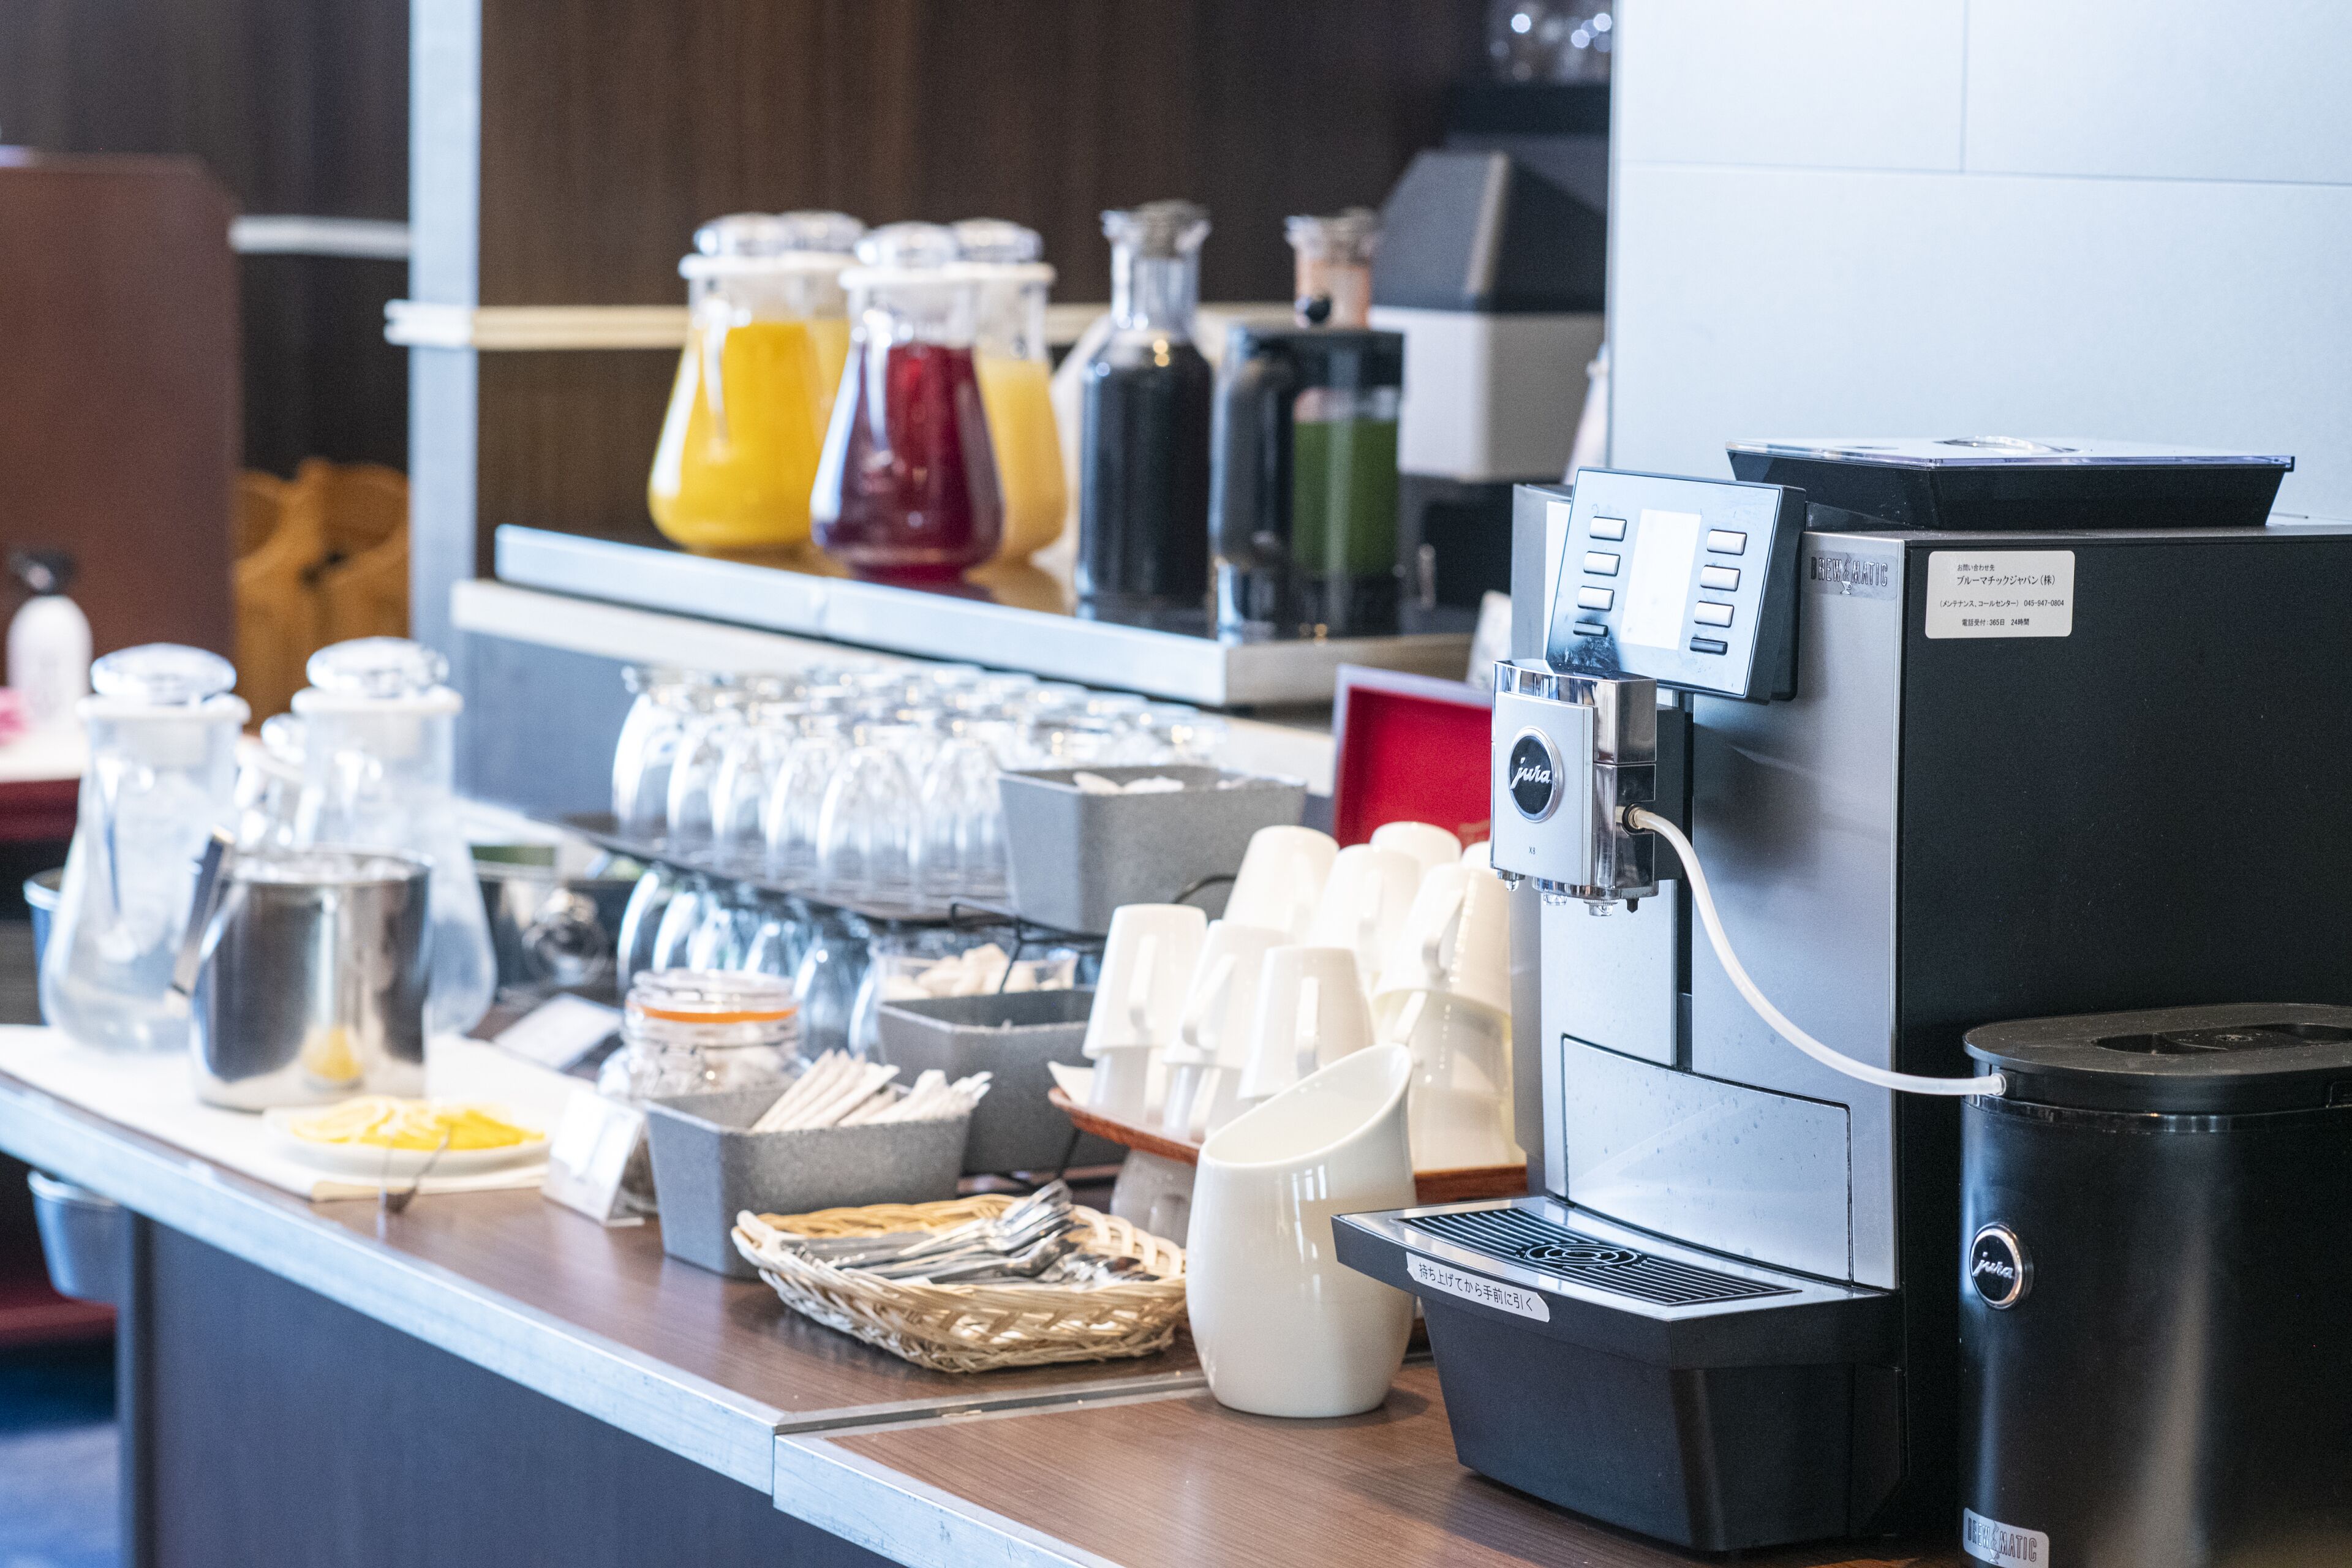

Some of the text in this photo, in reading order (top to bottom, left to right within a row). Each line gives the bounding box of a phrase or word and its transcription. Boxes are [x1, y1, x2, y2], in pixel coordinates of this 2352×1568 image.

[1957, 575, 2056, 586] ブルーマチックジャパン（株）
[1510, 756, 1552, 790] jura
[1528, 846, 1536, 855] X8
[1972, 1251, 2014, 1279] jura
[1419, 1262, 1532, 1311] 持ち上げてから手前に引く
